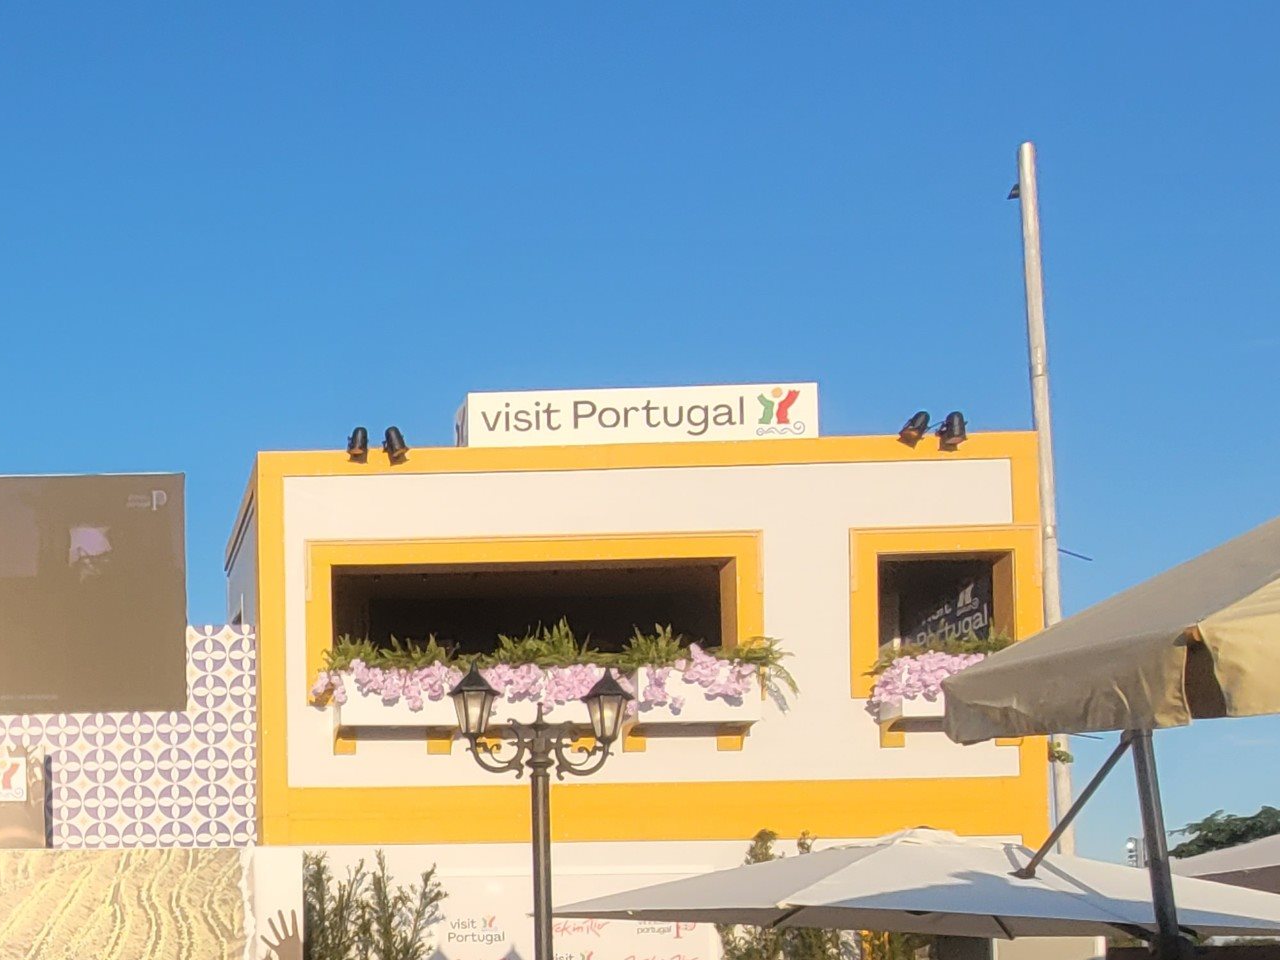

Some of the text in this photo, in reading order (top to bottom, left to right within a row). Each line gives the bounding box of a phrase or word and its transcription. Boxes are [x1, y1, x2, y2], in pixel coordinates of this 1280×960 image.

[482, 396, 745, 437] visit Portugal
[450, 917, 478, 930] visit
[448, 931, 506, 945] Portugal
